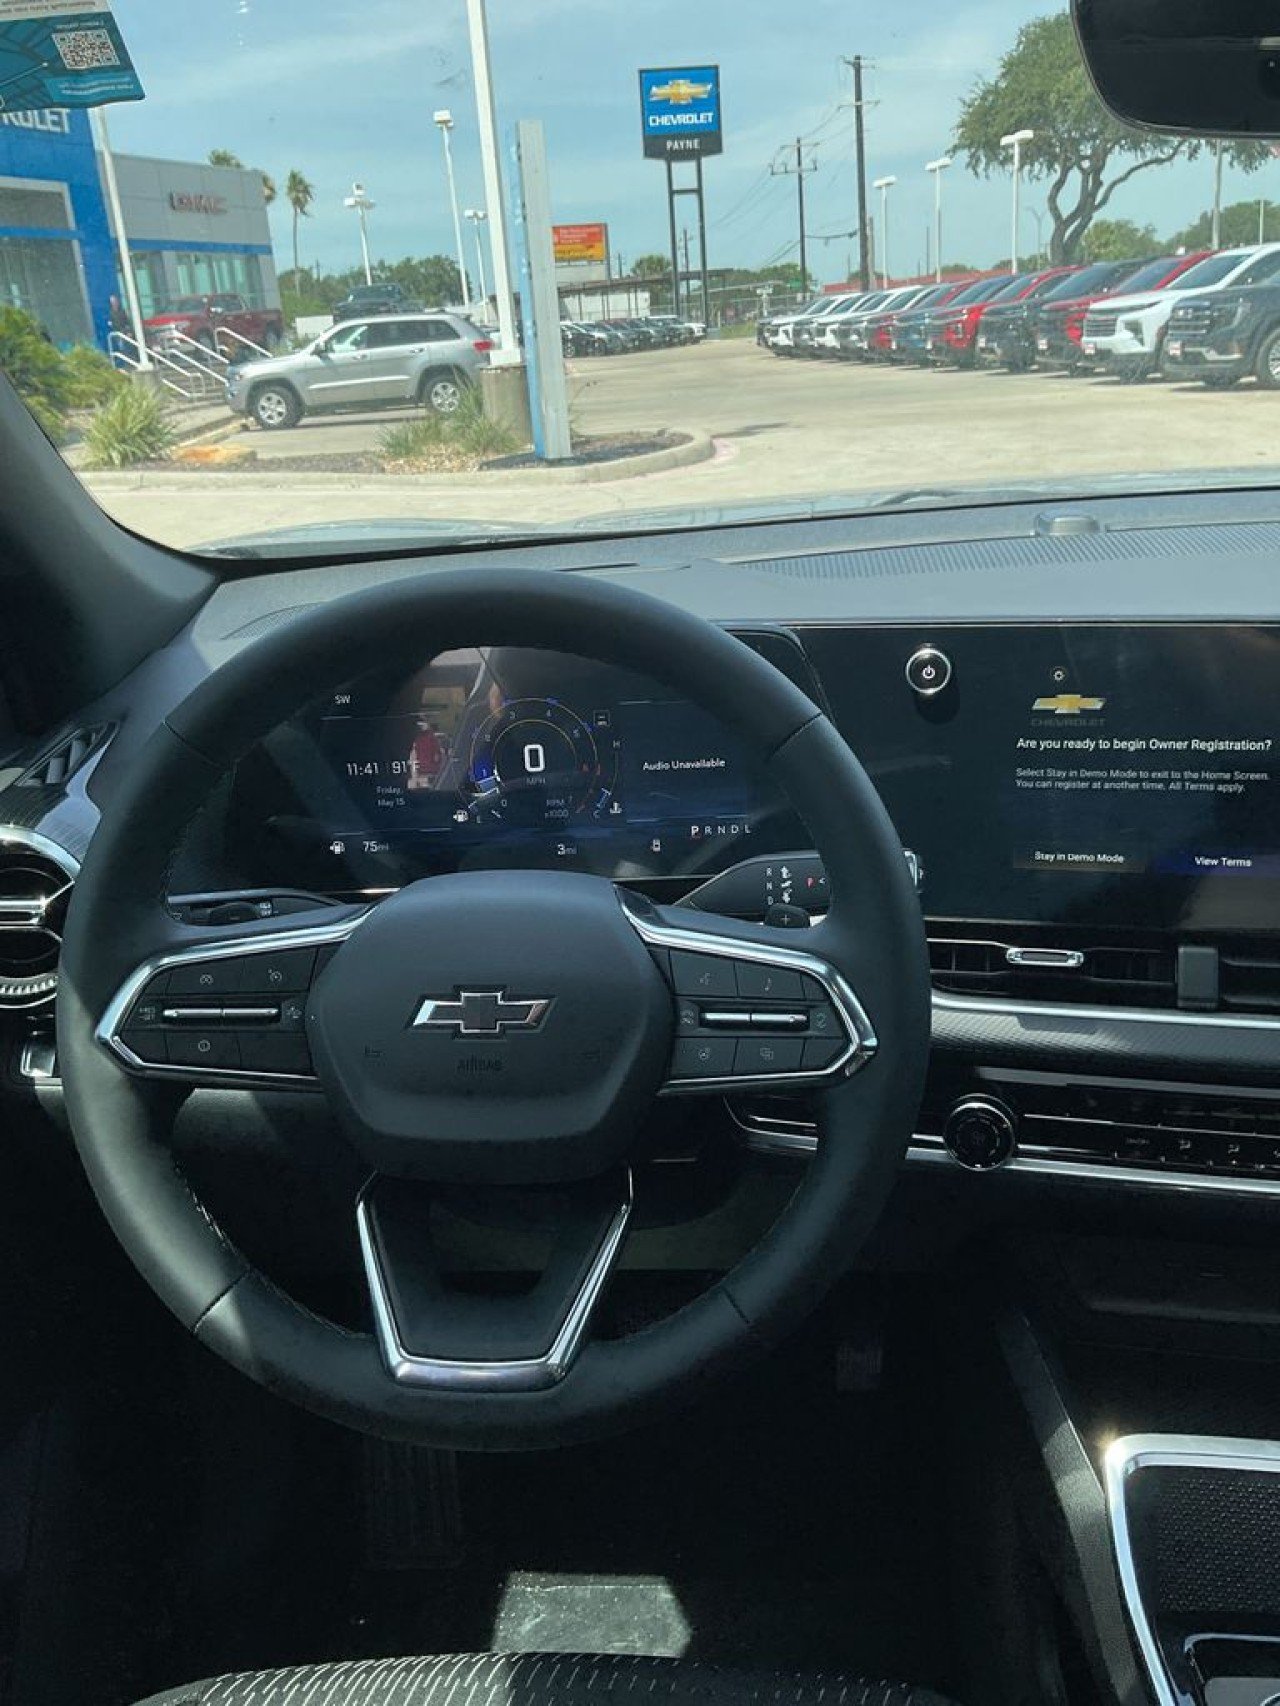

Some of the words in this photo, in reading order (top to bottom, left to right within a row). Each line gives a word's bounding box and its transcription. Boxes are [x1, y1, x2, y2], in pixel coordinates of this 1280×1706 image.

[649, 112, 714, 127] CHEVROLET
[666, 139, 701, 151] PAYNE
[1016, 738, 1038, 749] Are
[1040, 740, 1061, 751] you
[1063, 738, 1096, 752] ready
[1099, 739, 1111, 749] to
[1113, 738, 1146, 752] begin
[1149, 738, 1188, 750] Owner
[1191, 739, 1272, 753] Registration?
[523, 744, 546, 772] 0
[346, 762, 379, 776] 11:41
[642, 761, 670, 772] Audio
[672, 758, 726, 770] Unavailable
[1016, 767, 1044, 778] Select
[1046, 768, 1067, 779] Stay
[1069, 769, 1078, 777] in
[1080, 769, 1107, 778] Demo
[1110, 769, 1138, 779] Mode
[1140, 770, 1149, 779] to
[1151, 771, 1169, 779] exit
[1171, 771, 1181, 779] to
[1183, 770, 1199, 779] the
[1201, 771, 1231, 780] Home
[1015, 779, 1034, 788] You
[1035, 780, 1052, 788] can
[1055, 780, 1089, 791] register
[1092, 781, 1101, 789] at
[1103, 780, 1140, 790] another
[1169, 781, 1182, 790] All
[1185, 782, 1215, 791] Terms
[1034, 851, 1055, 862] Stay
[1057, 852, 1066, 861] in
[1068, 853, 1095, 862] Demo
[1097, 853, 1124, 863] Mode
[1194, 856, 1218, 866] View
[1221, 857, 1252, 867] Terms
